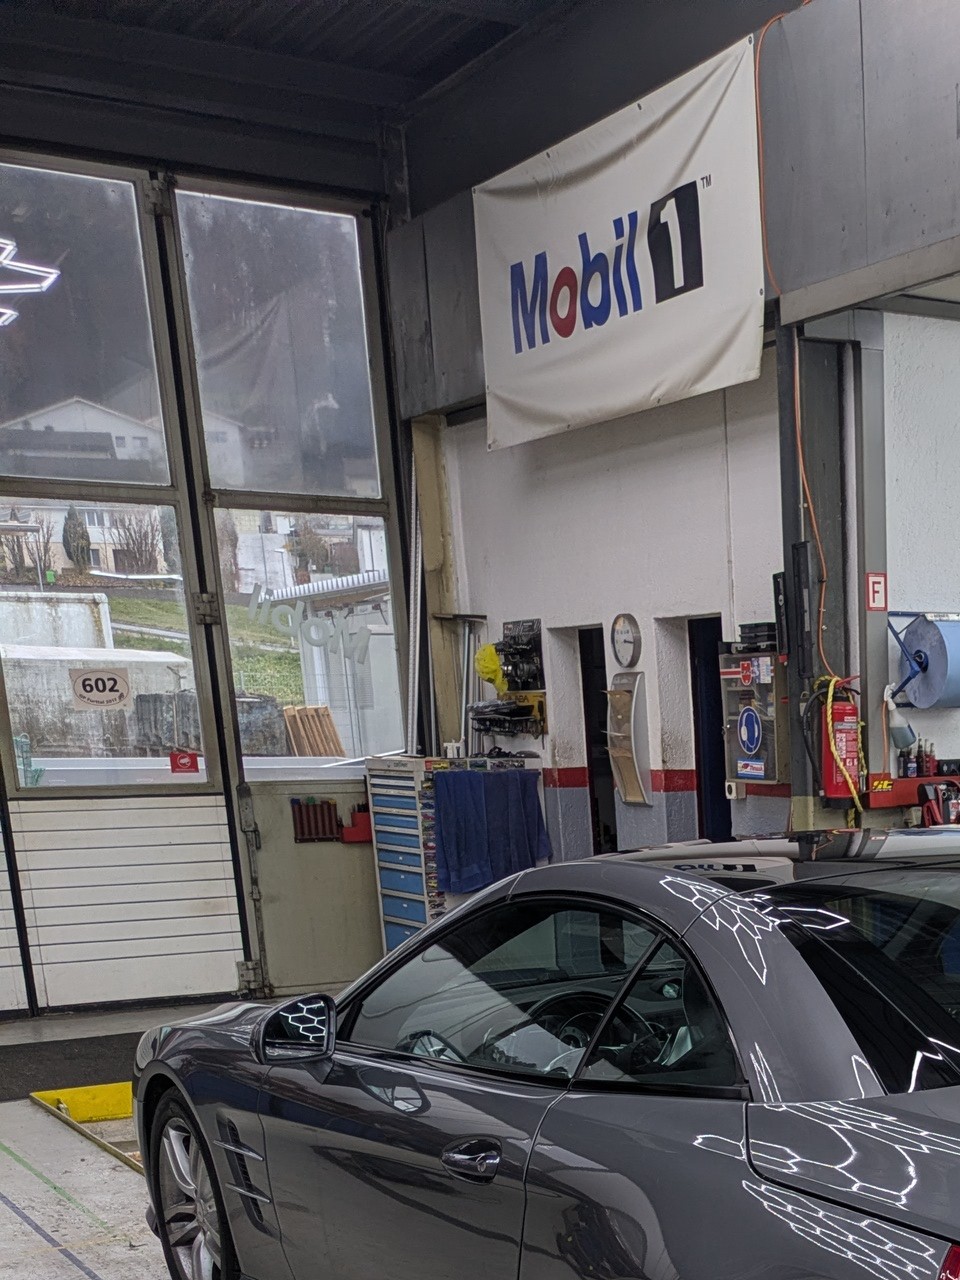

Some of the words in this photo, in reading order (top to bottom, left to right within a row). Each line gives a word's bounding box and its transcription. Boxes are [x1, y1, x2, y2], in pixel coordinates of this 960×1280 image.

[510, 210, 643, 354] Mobil
[872, 581, 882, 603] F
[82, 677, 120, 693] 602
